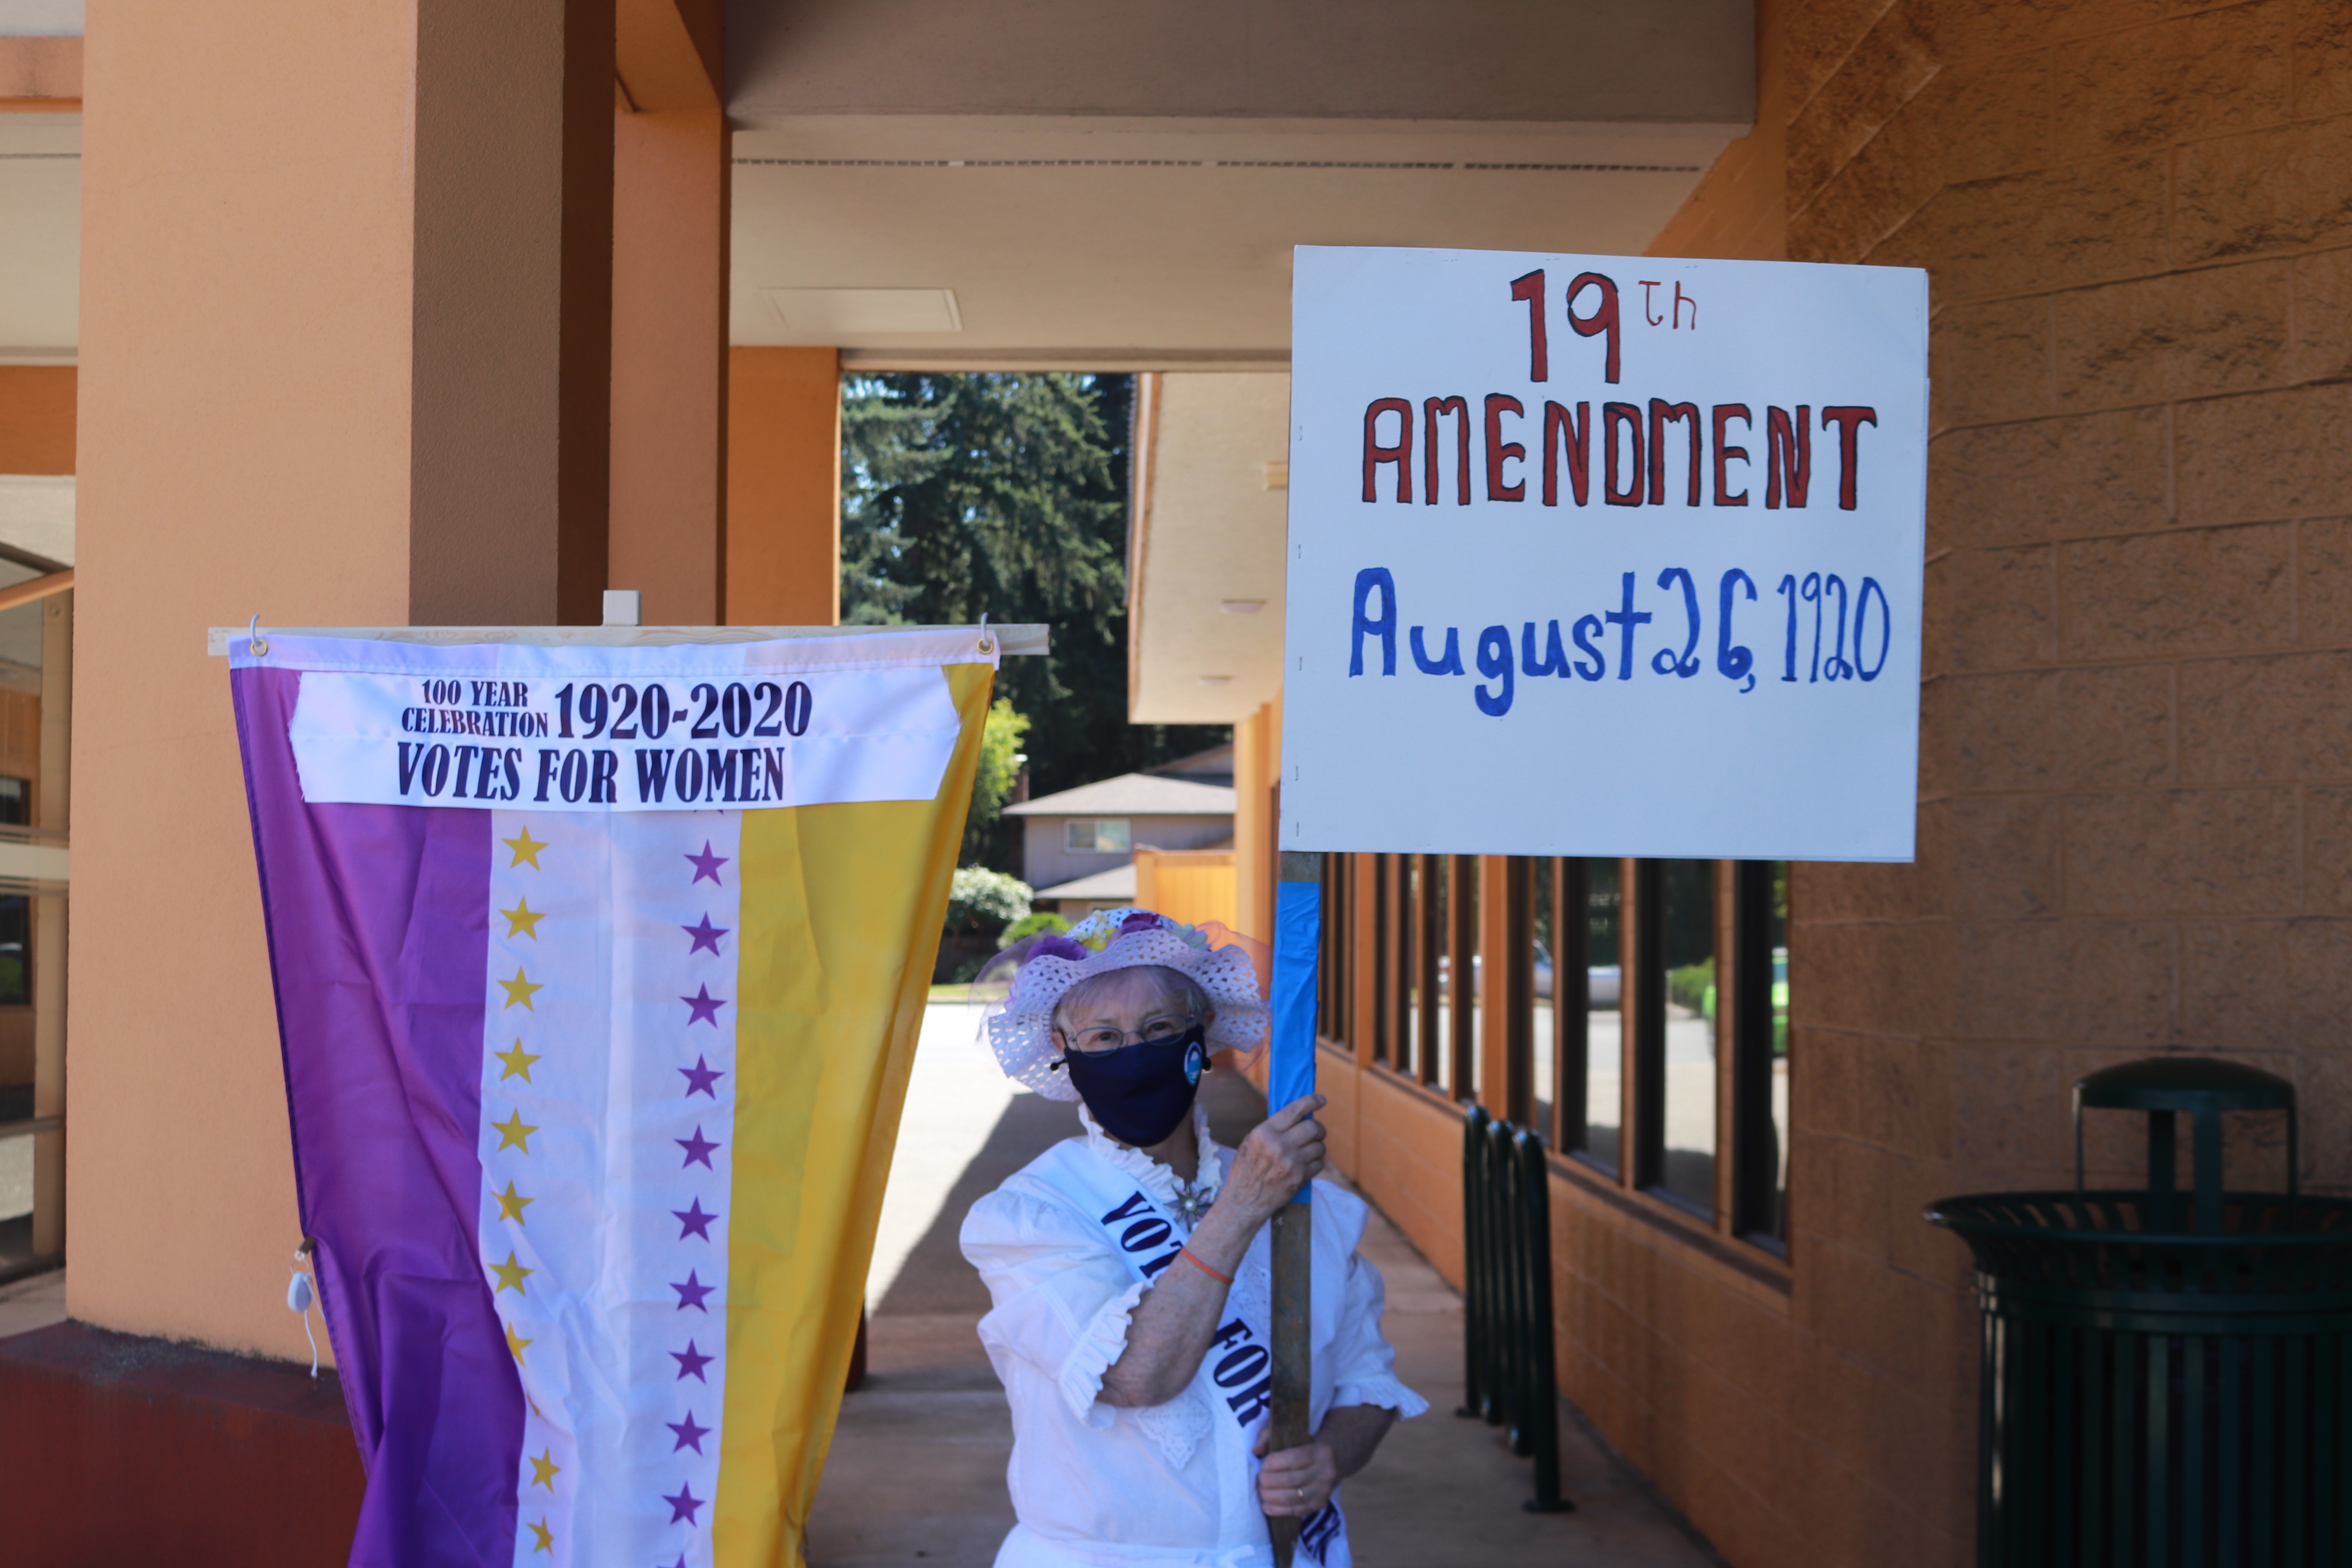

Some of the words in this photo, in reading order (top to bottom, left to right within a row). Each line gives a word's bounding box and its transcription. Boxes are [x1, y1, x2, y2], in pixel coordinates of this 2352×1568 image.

[1361, 392, 1878, 512] AMENDMENT
[1348, 566, 1652, 717] August
[1651, 567, 1758, 694] 26,
[1777, 572, 1891, 684] 1920
[401, 707, 548, 738] CELEBRATION
[421, 679, 462, 706] 100
[470, 680, 528, 708] YEAR
[555, 681, 813, 740] 1920-2020
[397, 741, 523, 801] VOTES
[533, 748, 619, 804] FOR
[634, 746, 785, 803] WOMEN
[1209, 1317, 1272, 1428] FOR
